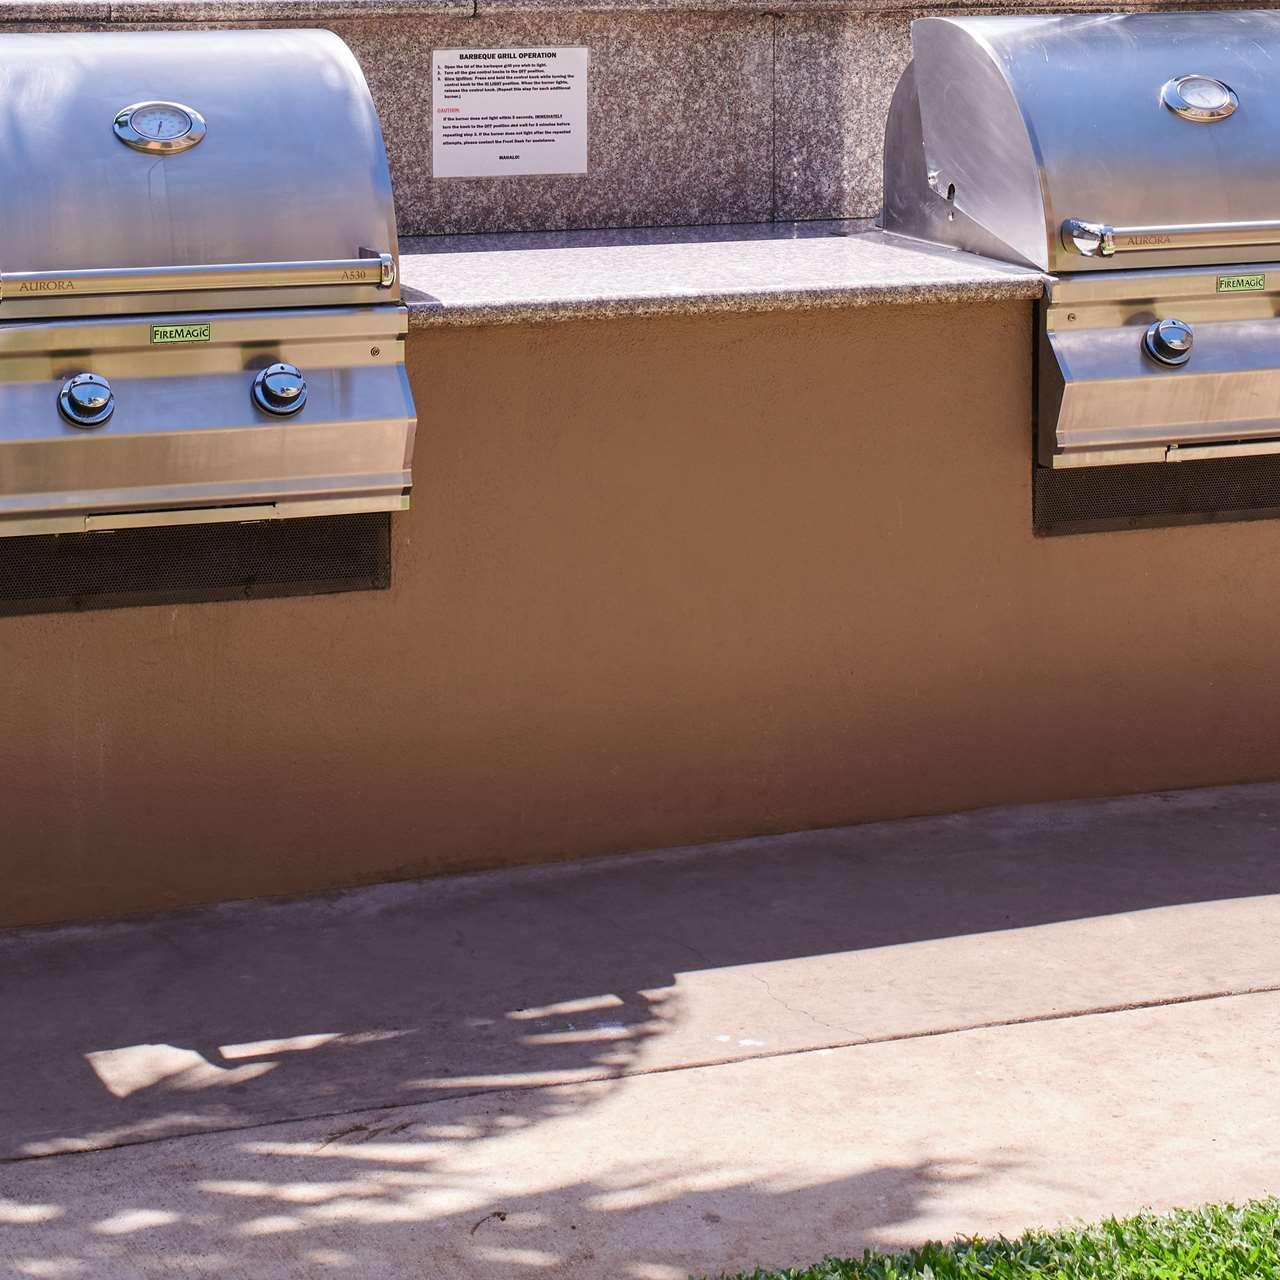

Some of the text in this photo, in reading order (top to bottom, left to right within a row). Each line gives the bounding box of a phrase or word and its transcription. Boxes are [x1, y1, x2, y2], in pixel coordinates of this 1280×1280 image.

[1127, 234, 1170, 245] AURORA
[341, 270, 366, 280] A530
[19, 280, 74, 292] AURORA
